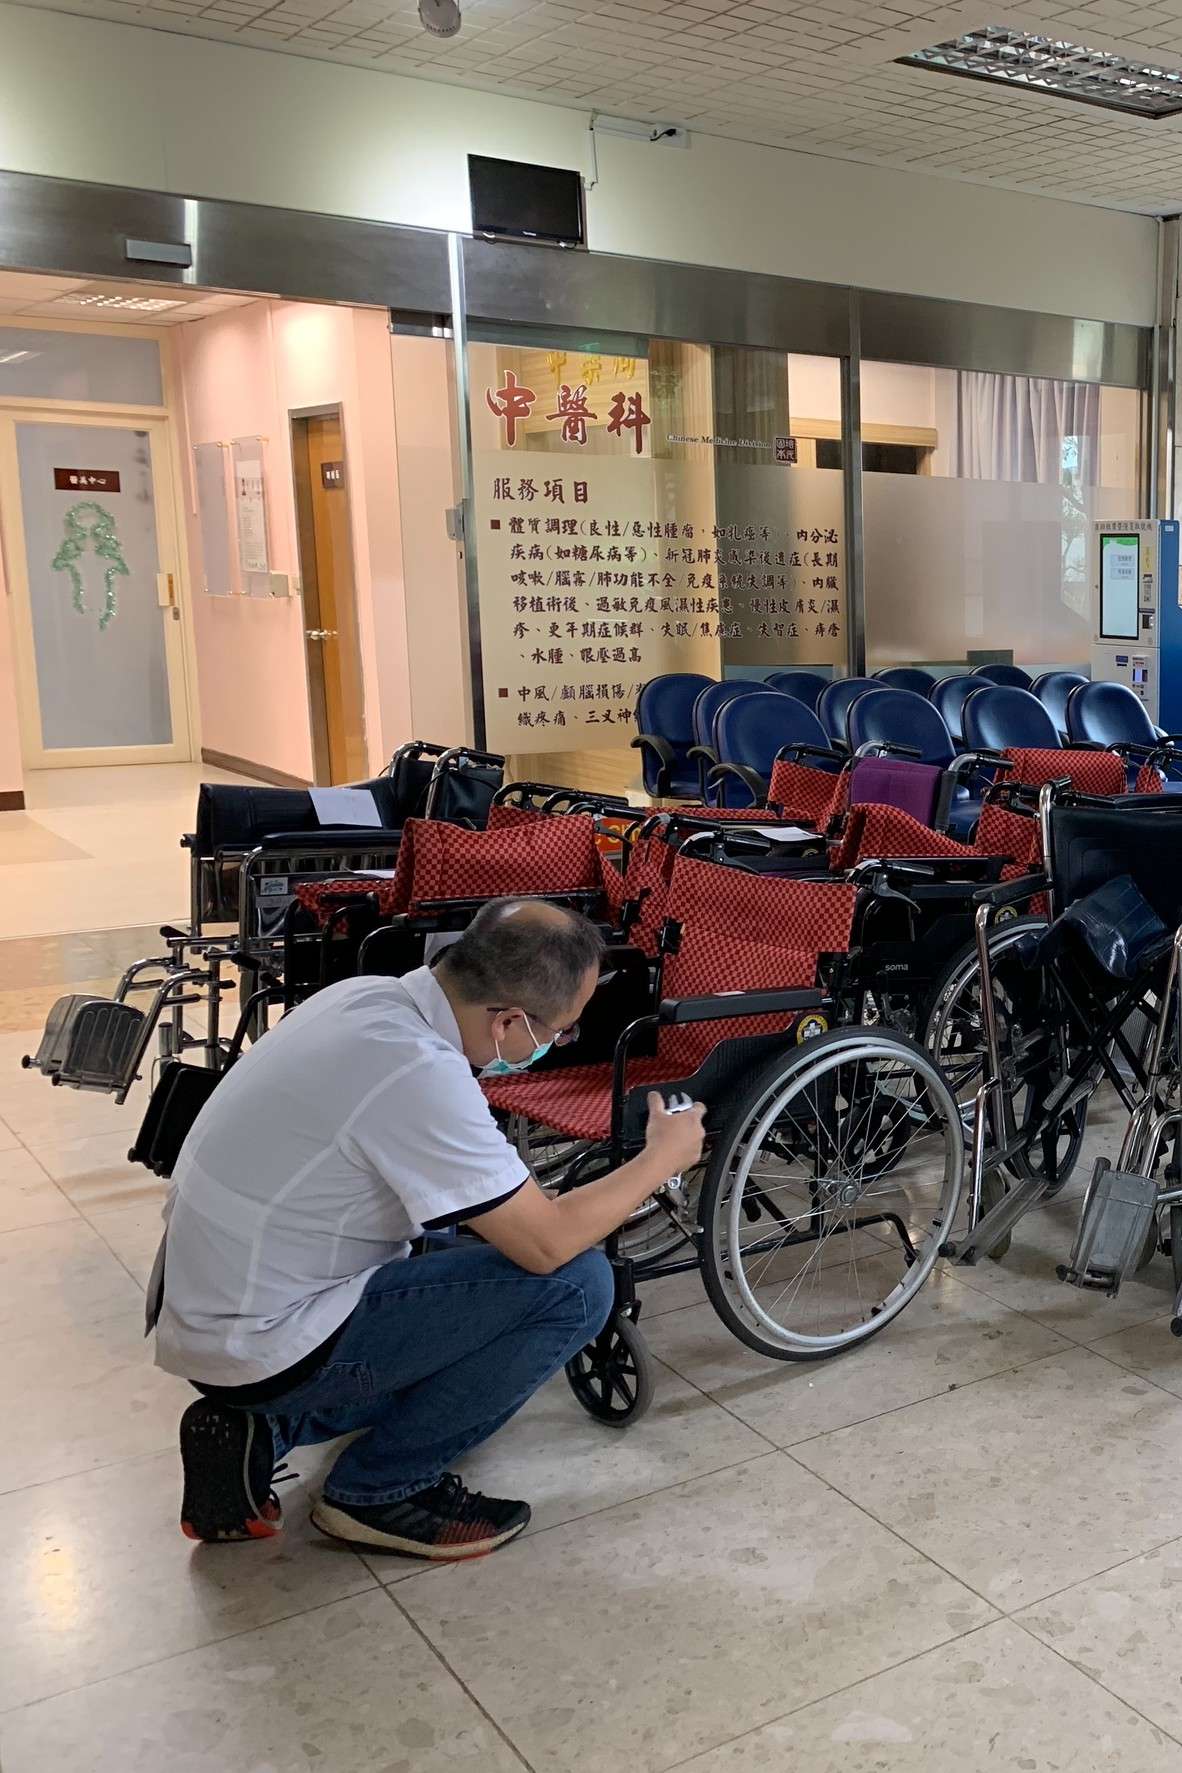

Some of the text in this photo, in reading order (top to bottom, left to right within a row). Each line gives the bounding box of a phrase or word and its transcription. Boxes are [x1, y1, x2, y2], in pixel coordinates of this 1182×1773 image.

[485, 369, 651, 455] 中醫科
[493, 477, 589, 504] 服務項目
[517, 708, 639, 727] 纖疼痛、三叉神
[884, 963, 909, 971] soma
